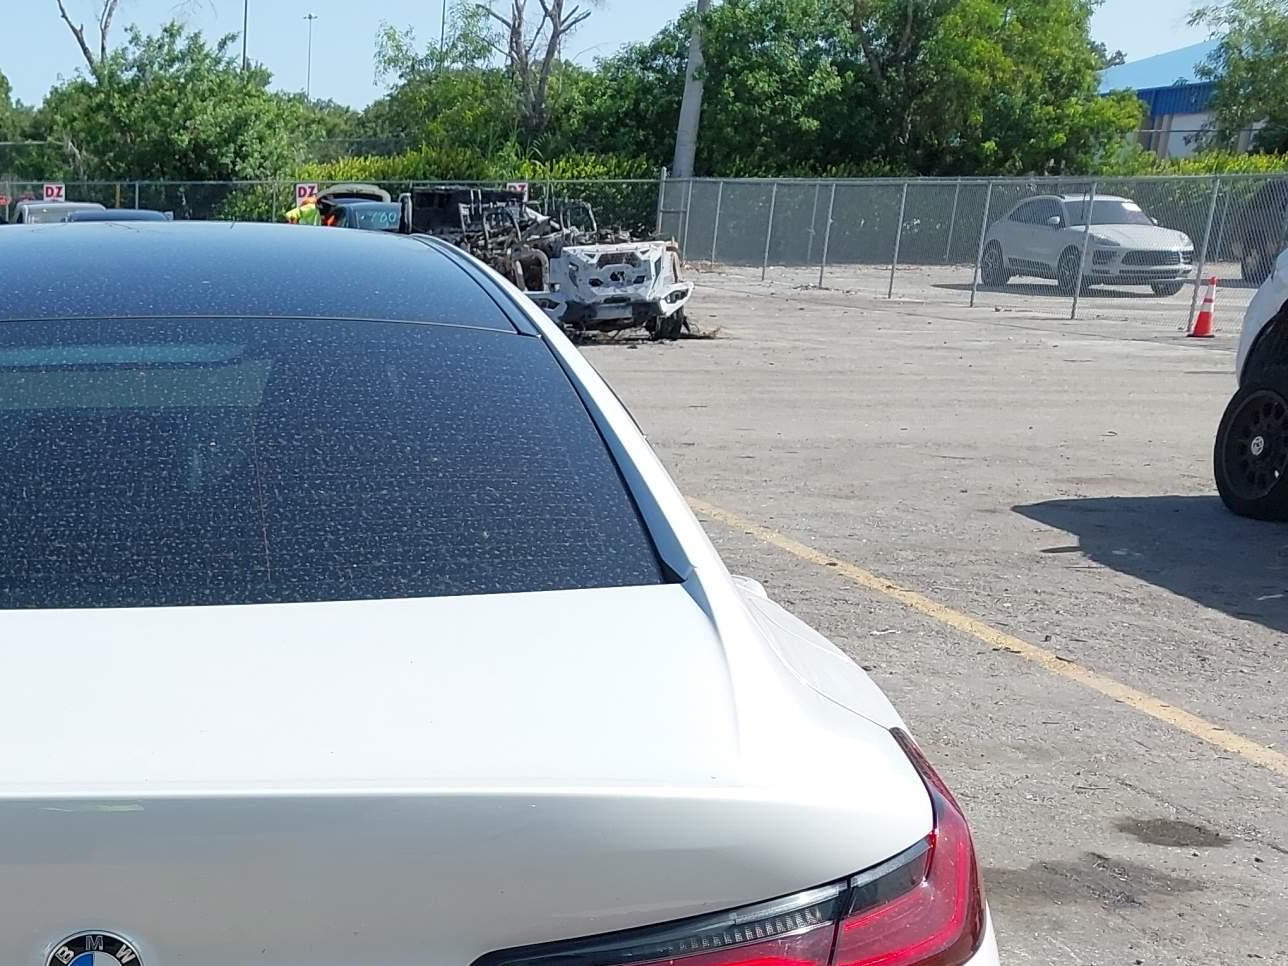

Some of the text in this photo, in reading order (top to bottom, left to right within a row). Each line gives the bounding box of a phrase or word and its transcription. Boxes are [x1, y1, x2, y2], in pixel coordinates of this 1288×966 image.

[45, 186, 63, 198] DZ
[297, 186, 316, 198] DZ
[55, 935, 137, 965] BMW
